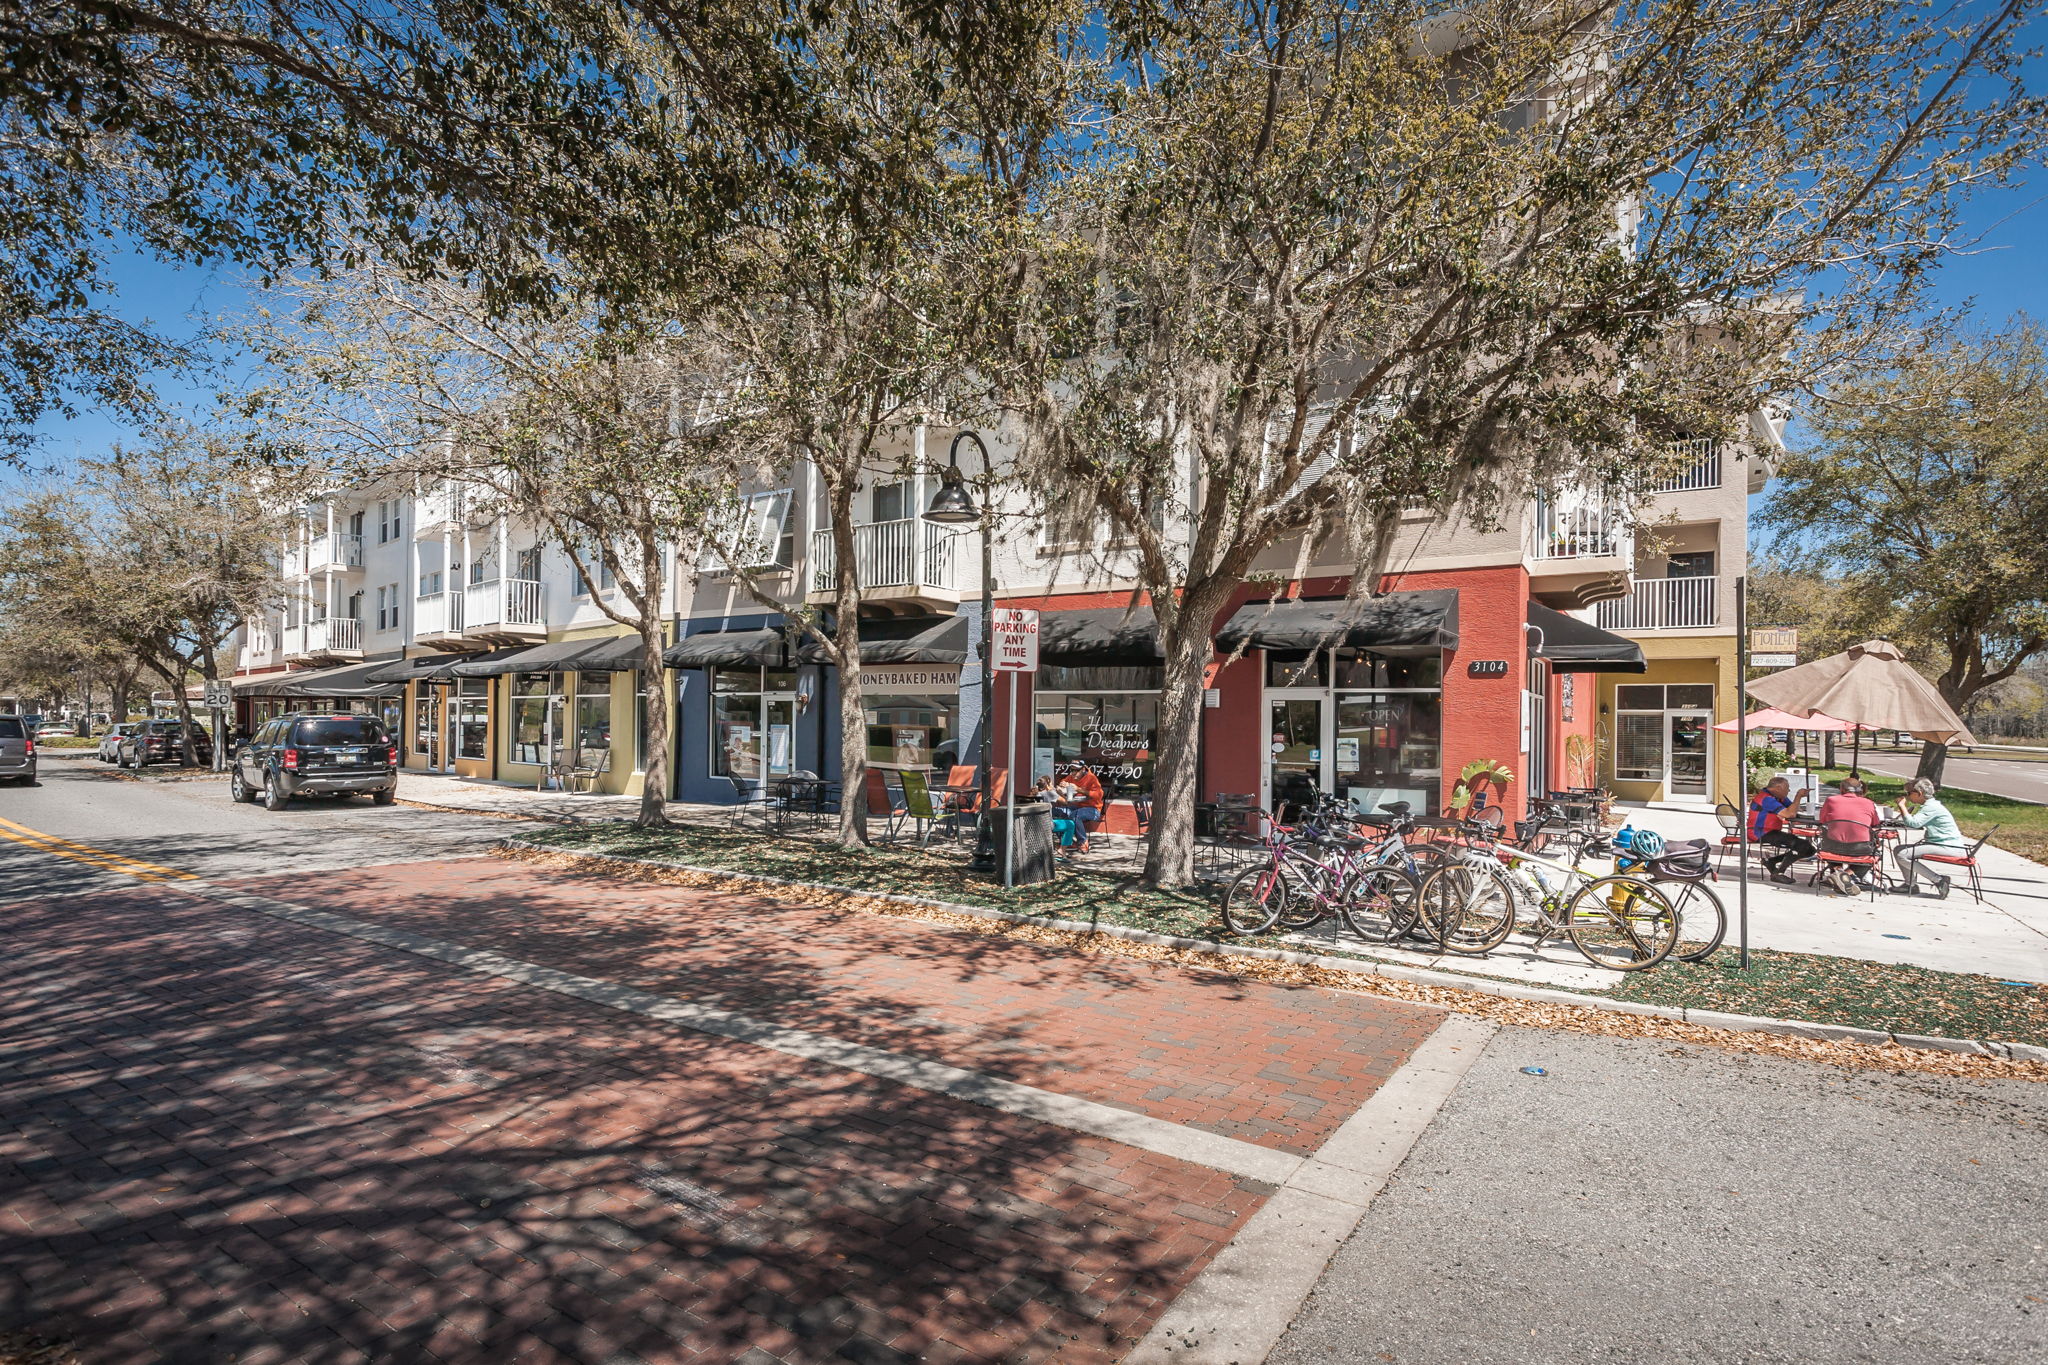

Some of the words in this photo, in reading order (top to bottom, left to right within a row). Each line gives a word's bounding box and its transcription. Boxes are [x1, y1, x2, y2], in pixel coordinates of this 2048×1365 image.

[1009, 611, 1023, 622] NO
[994, 622, 1037, 634] PARKING
[1004, 635, 1025, 645] ANY
[1752, 631, 1796, 646] PIONEER
[1002, 646, 1027, 657] TIME
[1473, 661, 1505, 672] 3104
[930, 672, 957, 685] HAM
[207, 694, 229, 705] 20
[1082, 710, 1139, 732] Havana
[1370, 708, 1400, 722] OPEN
[1086, 731, 1149, 750] Dreamers
